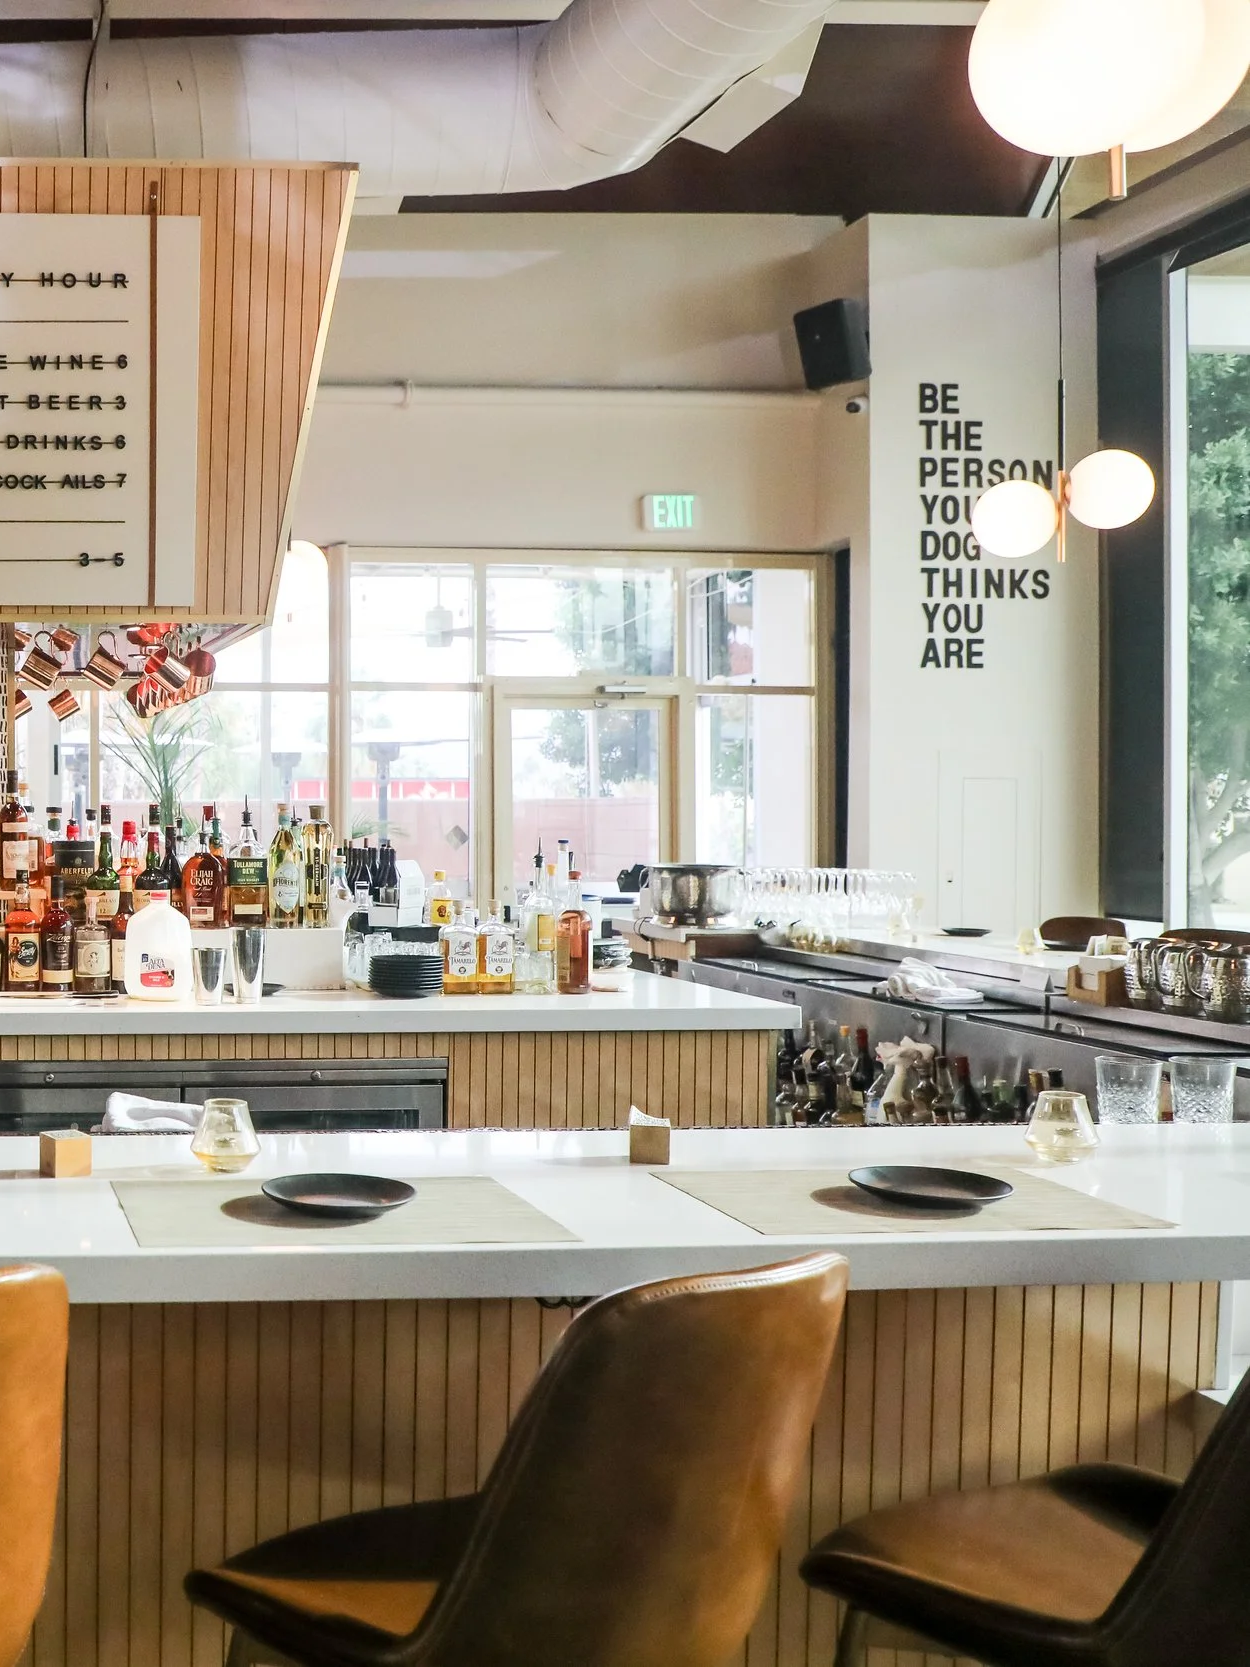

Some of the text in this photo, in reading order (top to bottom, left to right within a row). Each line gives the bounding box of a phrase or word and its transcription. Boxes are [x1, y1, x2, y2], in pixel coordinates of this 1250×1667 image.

[40, 272, 127, 289] HOUR
[29, 354, 103, 371] WINE
[116, 354, 128, 370] 6
[27, 394, 102, 411] BEER
[115, 395, 126, 411] 3
[918, 383, 960, 414] BE
[5, 434, 103, 451] DRINKS
[114, 434, 126, 450] 6
[919, 420, 983, 451] THE
[116, 473, 127, 488] 7
[919, 457, 1053, 491] PERSON
[652, 495, 694, 528] EXIT
[920, 531, 981, 561] DOG
[921, 568, 1050, 599] THINKS
[922, 603, 983, 633] YOU
[920, 638, 984, 668] ARE
[233, 860, 264, 868] TULLAMORE
[190, 869, 214, 878] ELIJAH
[190, 877, 214, 887] CRAIG
[448, 955, 476, 965] TAMARELO
[486, 955, 513, 965] TAMARELO
